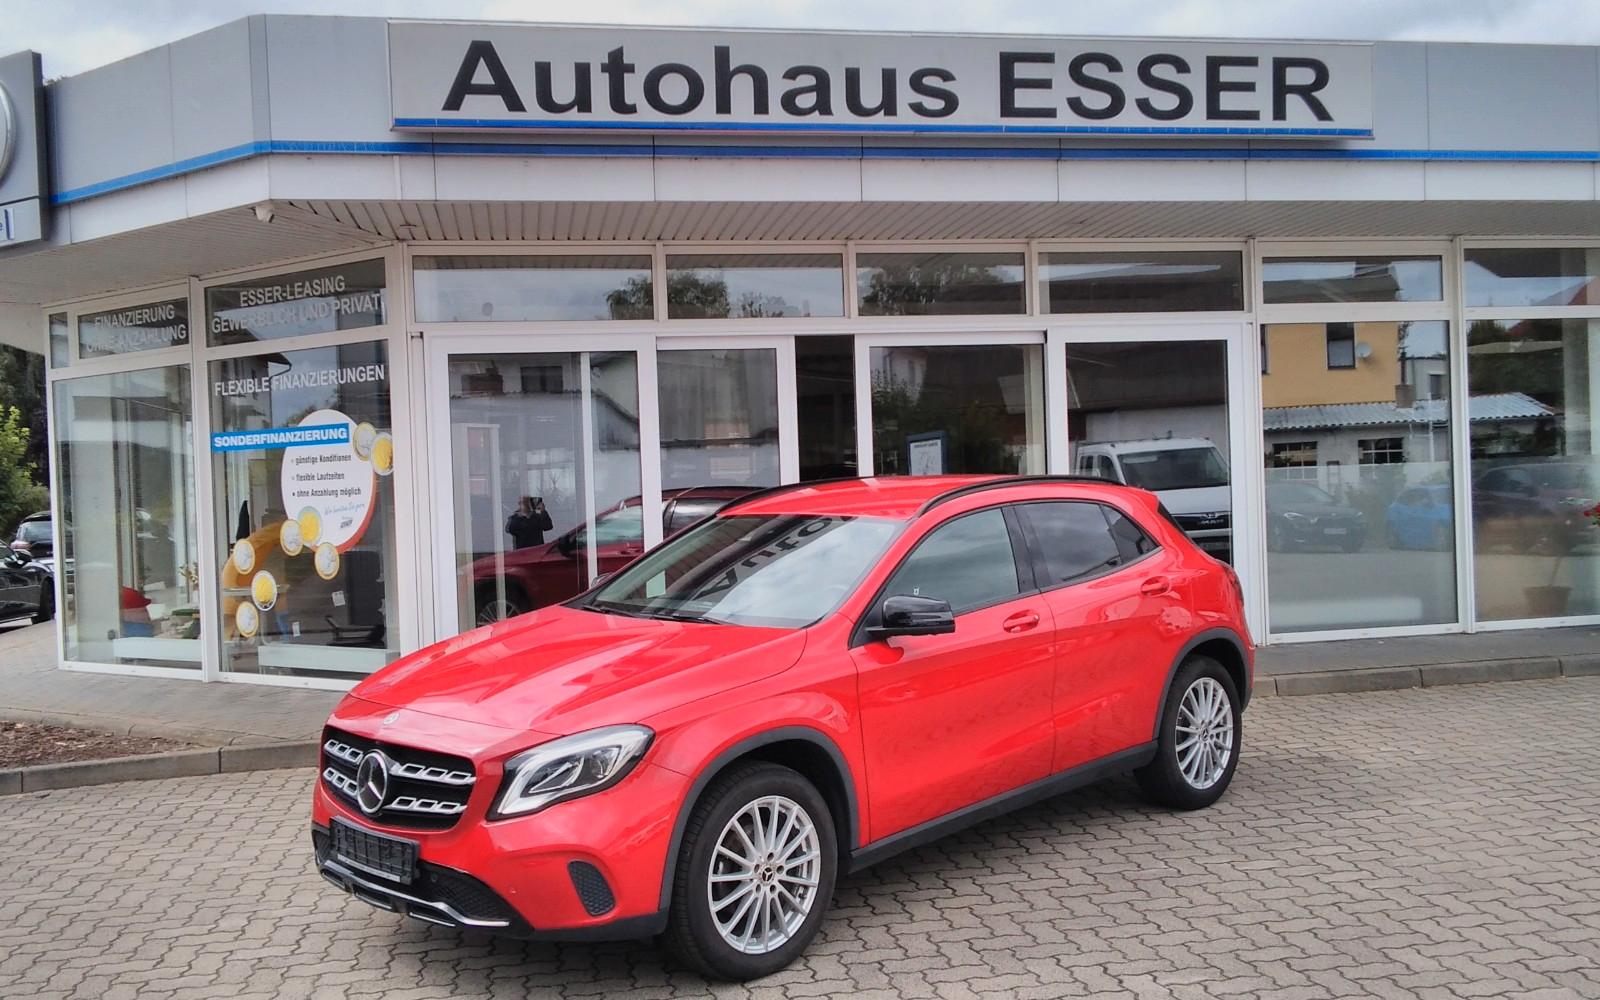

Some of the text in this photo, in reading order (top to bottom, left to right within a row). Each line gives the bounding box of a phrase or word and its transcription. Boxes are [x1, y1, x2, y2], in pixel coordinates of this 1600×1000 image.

[441, 39, 1334, 121] Autohaus ESSER
[240, 275, 345, 307] ESSER-LEASING
[94, 304, 175, 329] FINANZIERUNG
[211, 293, 380, 333] GEWERBLICH UND PRIVAT
[214, 364, 385, 396] FLEXIBLE FINANZIERUNGEN
[213, 427, 348, 448] SONDERFINANZIERUNG
[295, 454, 352, 465] günstige Konditionen
[317, 472, 345, 480] Laufzeiten
[297, 487, 362, 498] ohne Anzahlung möglich
